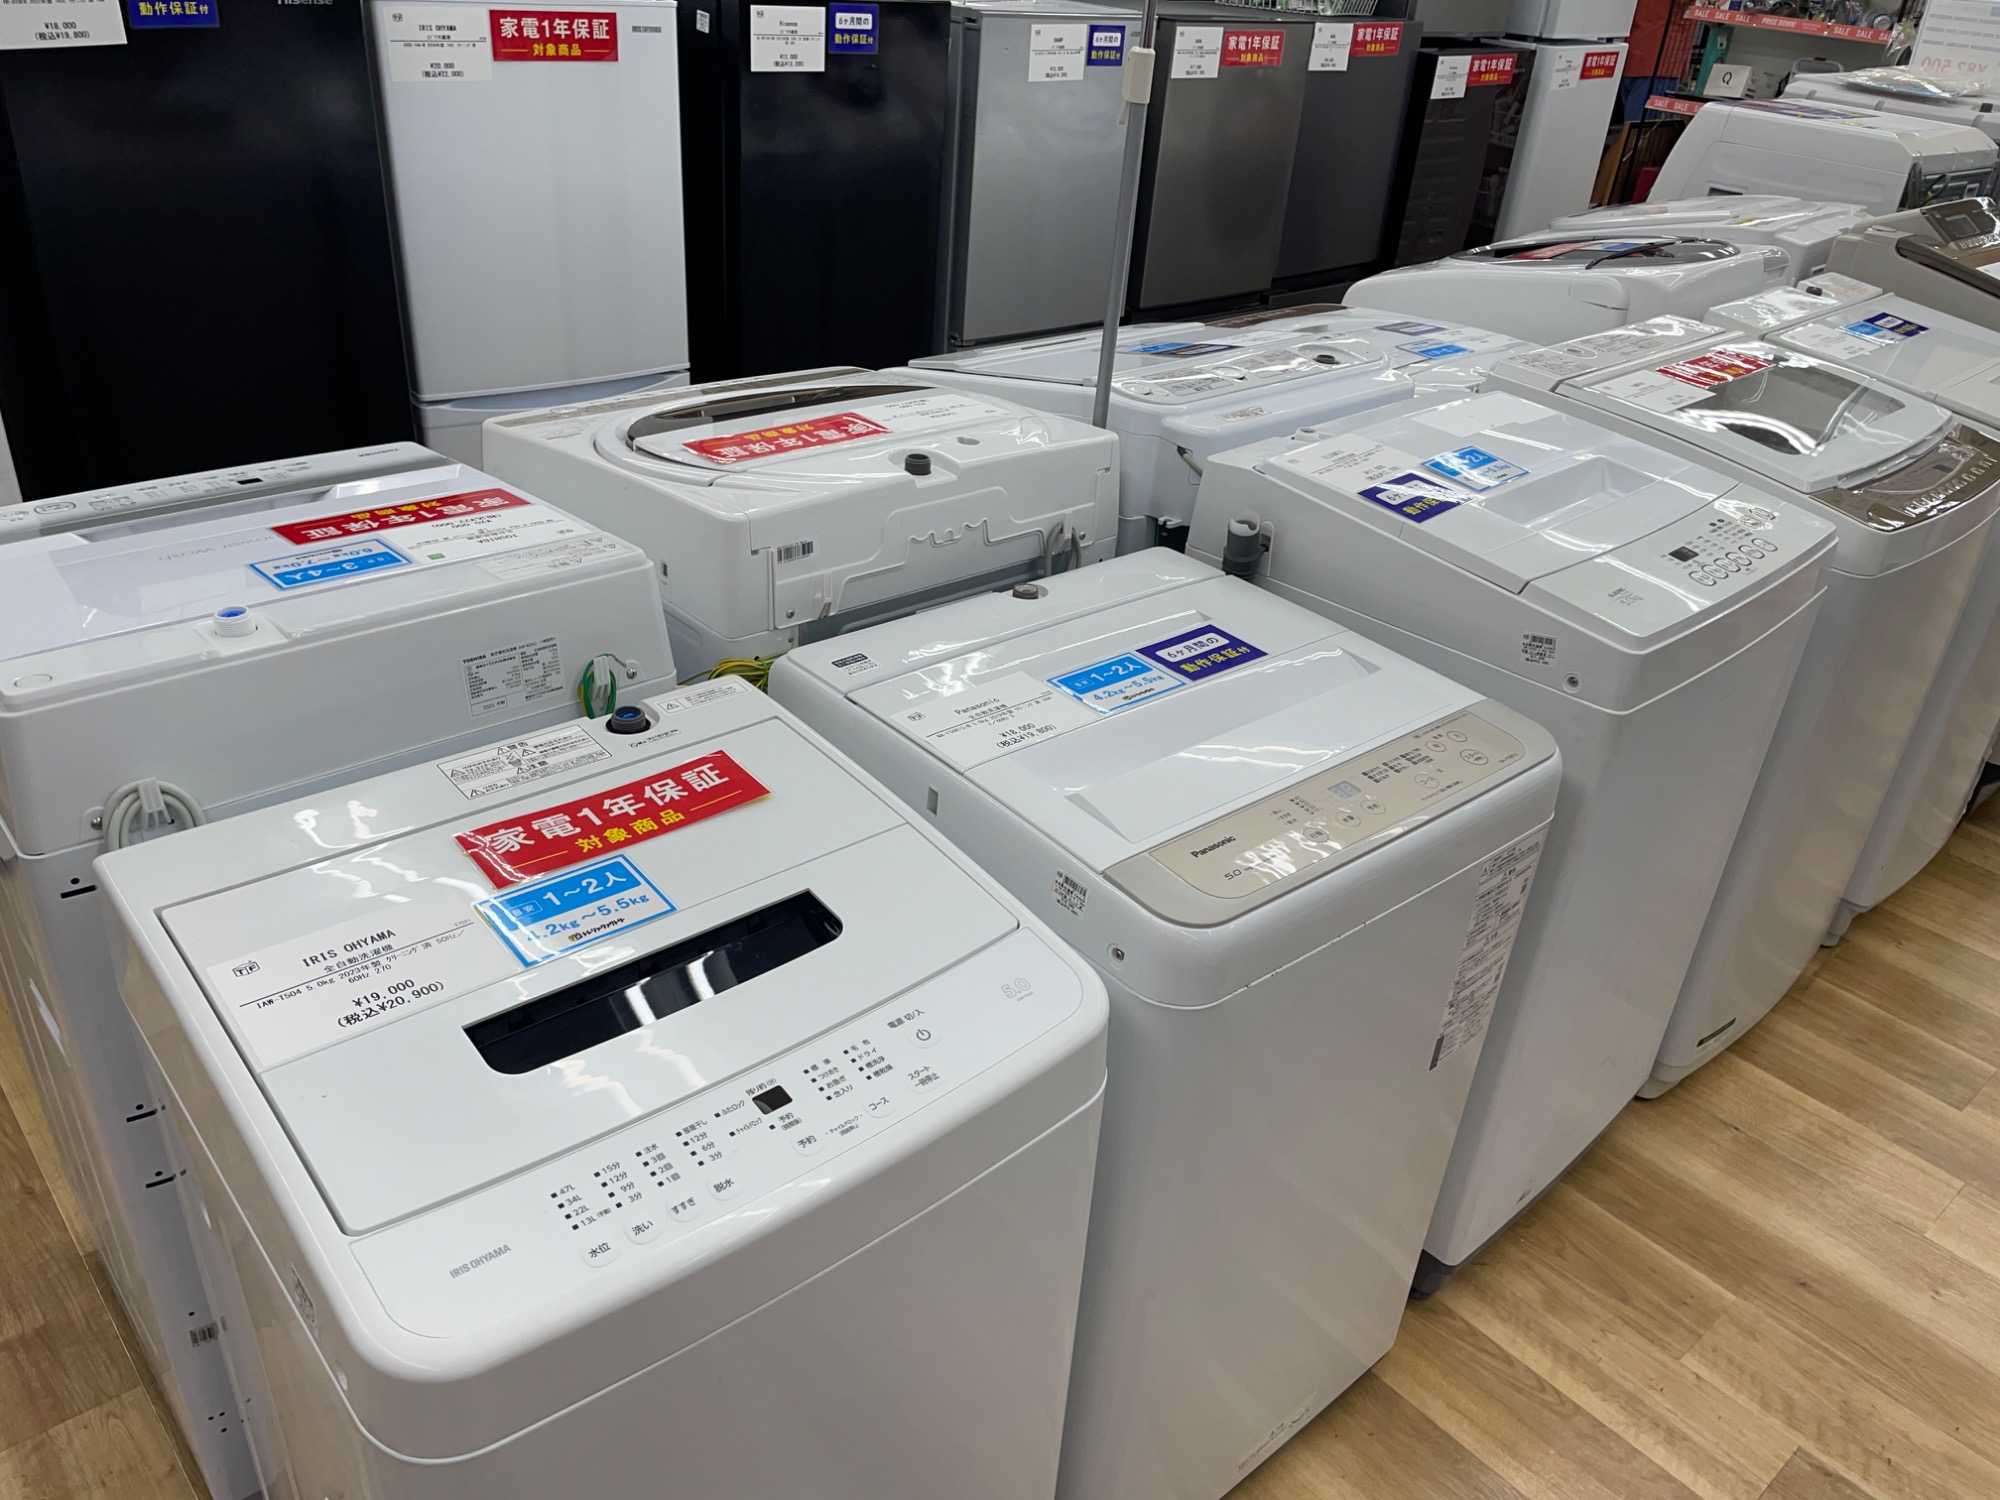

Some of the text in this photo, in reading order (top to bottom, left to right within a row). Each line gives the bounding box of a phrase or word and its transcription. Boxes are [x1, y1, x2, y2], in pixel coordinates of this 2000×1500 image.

[838, 17, 870, 26] 6ヶ月間の
[1694, 9, 1751, 23] SALE SALE SALE
[1761, 17, 1777, 27] PRICE
[1777, 19, 1797, 29] DOWN!
[44, 22, 77, 30] ¥18,000
[499, 18, 610, 40] 家電1年保証
[1834, 26, 1849, 36] SALE
[1856, 29, 1872, 39] SALE
[834, 34, 873, 45] 動作保証付
[1356, 27, 1399, 42] 家電1年保証
[532, 43, 582, 56] 対象商品
[1227, 34, 1280, 51] 家電1年保証
[1239, 53, 1264, 62] 対象商品
[1472, 57, 1513, 73] 家電1年保証
[1585, 54, 1618, 68] 家電1年保証
[1654, 98, 1669, 108] SALE
[1674, 101, 1688, 111] SALE
[714, 422, 875, 458] 家電1年保証
[350, 499, 443, 521] 対象商品
[300, 497, 511, 540] 家電1年保証
[1167, 634, 1220, 659] 6ヶ月間の
[1180, 645, 1252, 675] 動作保証付
[1095, 660, 1142, 685] 1～2人
[954, 696, 1001, 716] Panasonic
[995, 723, 1058, 750] (税込¥19,800)
[999, 723, 1036, 738] ¥18,000
[486, 763, 729, 854] 家電1年保証
[574, 808, 686, 853] 対象商品
[1190, 834, 1237, 860] Panasonic
[1224, 868, 1243, 881] 5.0
[541, 870, 628, 908] 1～2人
[528, 893, 650, 942] 4.2kg～5.5kg
[302, 929, 396, 967] IRIS OHYAMA
[322, 943, 395, 973] 全自動洗濯機
[306, 977, 336, 992] 5.0kg
[338, 961, 382, 979] 2023年製
[421, 940, 433, 950] 済
[348, 971, 370, 983] 60Hz
[352, 979, 416, 1007] ¥19,000
[1001, 977, 1031, 1000] 5.0
[337, 981, 445, 1028] (税込¥20,900)
[857, 1047, 878, 1061] ドライ
[907, 1065, 931, 1081] スタート
[913, 1072, 940, 1088] 一時停止
[721, 1100, 745, 1115] ふたロック
[868, 1096, 890, 1111] コース
[778, 1111, 794, 1124] 予約
[690, 1131, 708, 1144] 12分
[796, 1134, 817, 1149] 予約
[702, 1141, 715, 1152] 6分
[709, 1151, 723, 1162] 3分
[602, 1161, 621, 1174] 15分
[609, 1171, 628, 1184] 12分
[713, 1177, 734, 1193] 脱水
[559, 1183, 576, 1195] 47L
[620, 1181, 635, 1193] 9分
[566, 1194, 583, 1206] 34L
[628, 1191, 642, 1203] 3分
[573, 1205, 590, 1217] 22L
[671, 1196, 697, 1215] すすぎ
[581, 1215, 598, 1227] 13L
[631, 1220, 654, 1236] 洗い
[588, 1242, 611, 1258] 水位
[449, 1243, 512, 1280] IRIS OHYAMA
